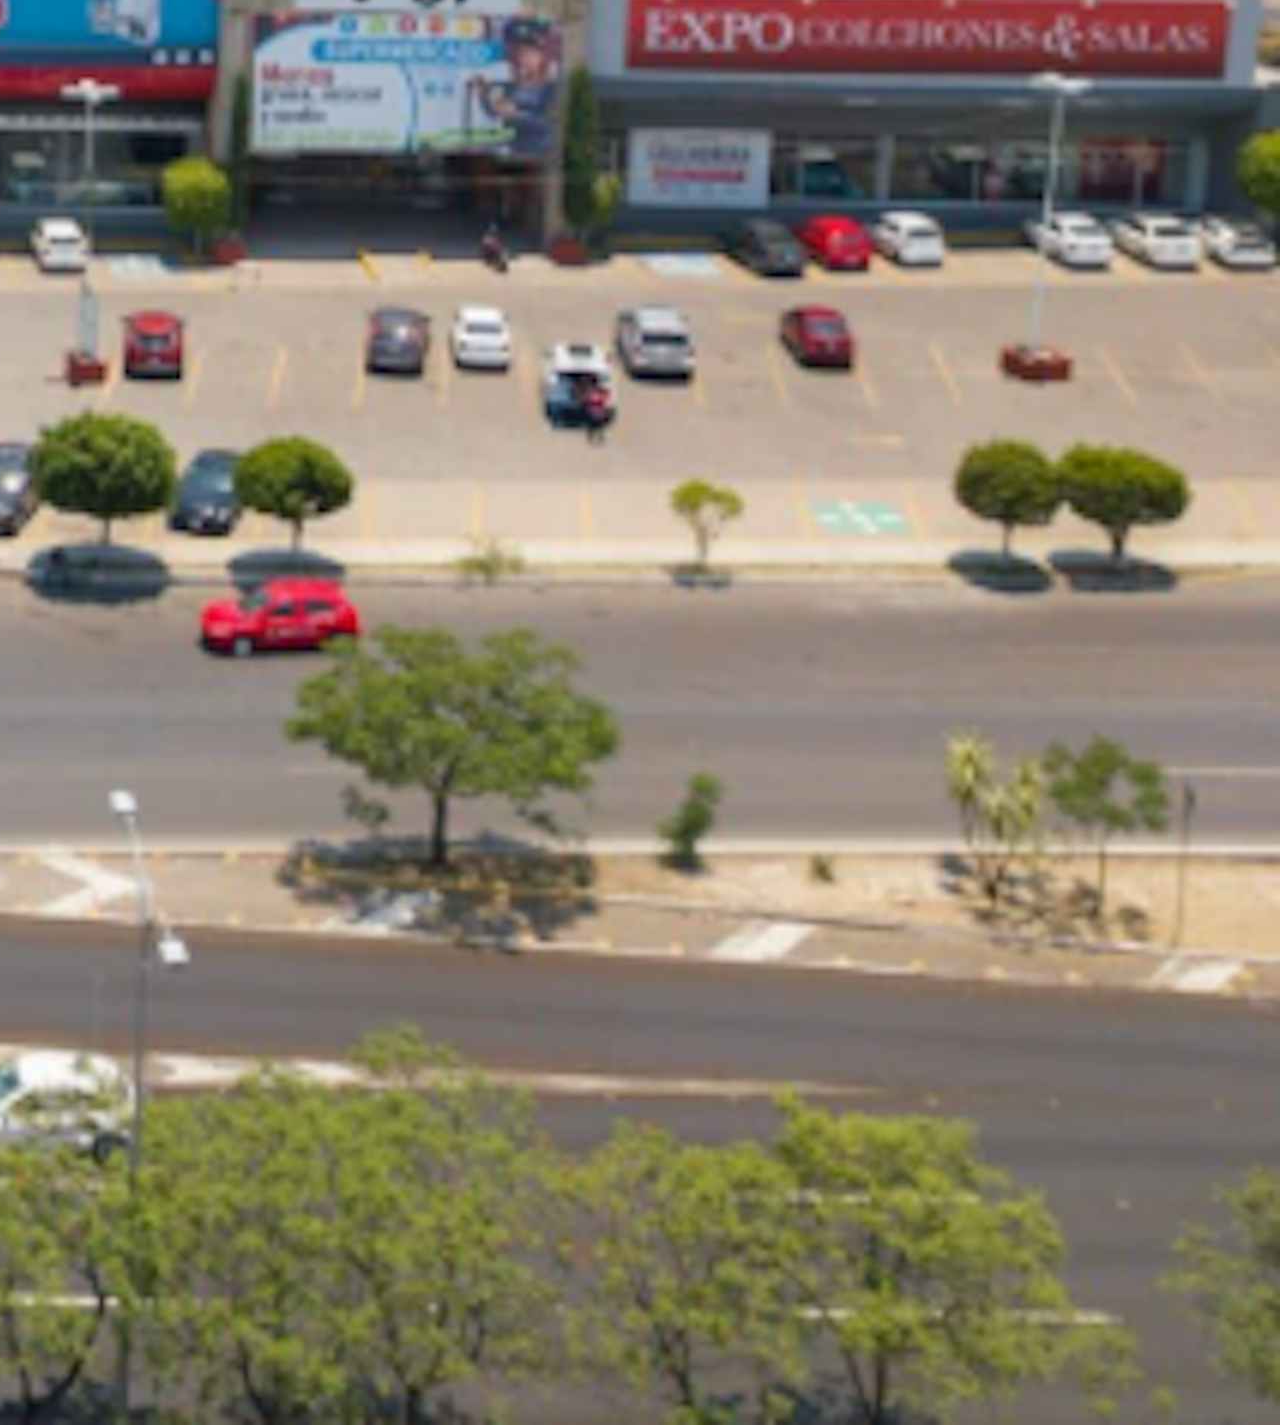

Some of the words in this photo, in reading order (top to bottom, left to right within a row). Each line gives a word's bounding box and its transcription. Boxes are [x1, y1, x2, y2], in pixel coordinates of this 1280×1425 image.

[644, 8, 794, 53] EXPO
[799, 19, 1037, 51] COLCHONES
[1042, 12, 1084, 60] &
[1088, 23, 1209, 52] SALAS
